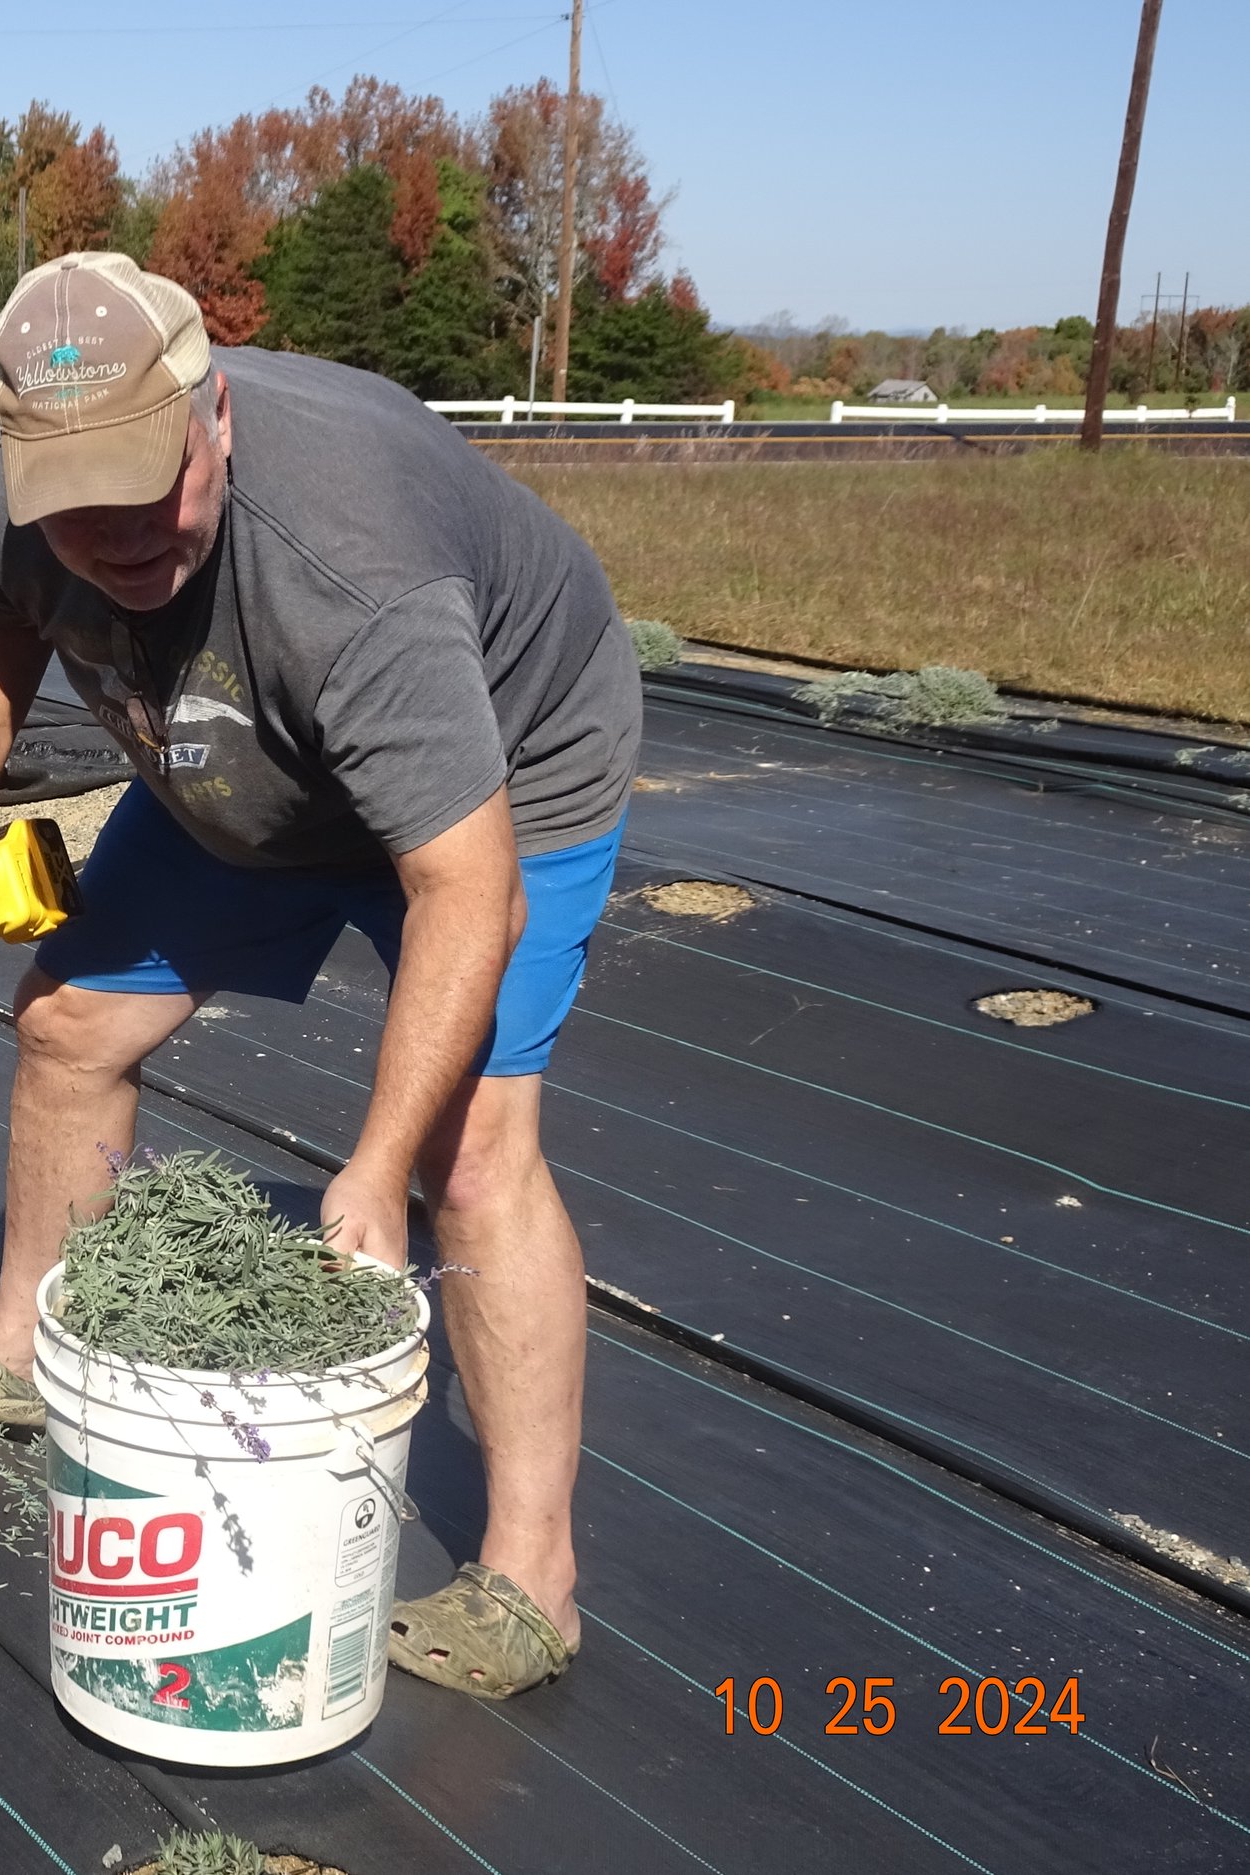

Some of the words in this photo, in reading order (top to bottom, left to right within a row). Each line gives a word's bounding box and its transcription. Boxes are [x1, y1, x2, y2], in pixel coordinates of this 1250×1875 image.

[16, 360, 126, 393] Yellowstone
[32, 400, 80, 411] NATIONAL
[84, 388, 109, 403] PARK
[70, 1630, 101, 1644] JOINT
[105, 1630, 195, 1645] COMPOUND
[152, 1662, 190, 1710] 2
